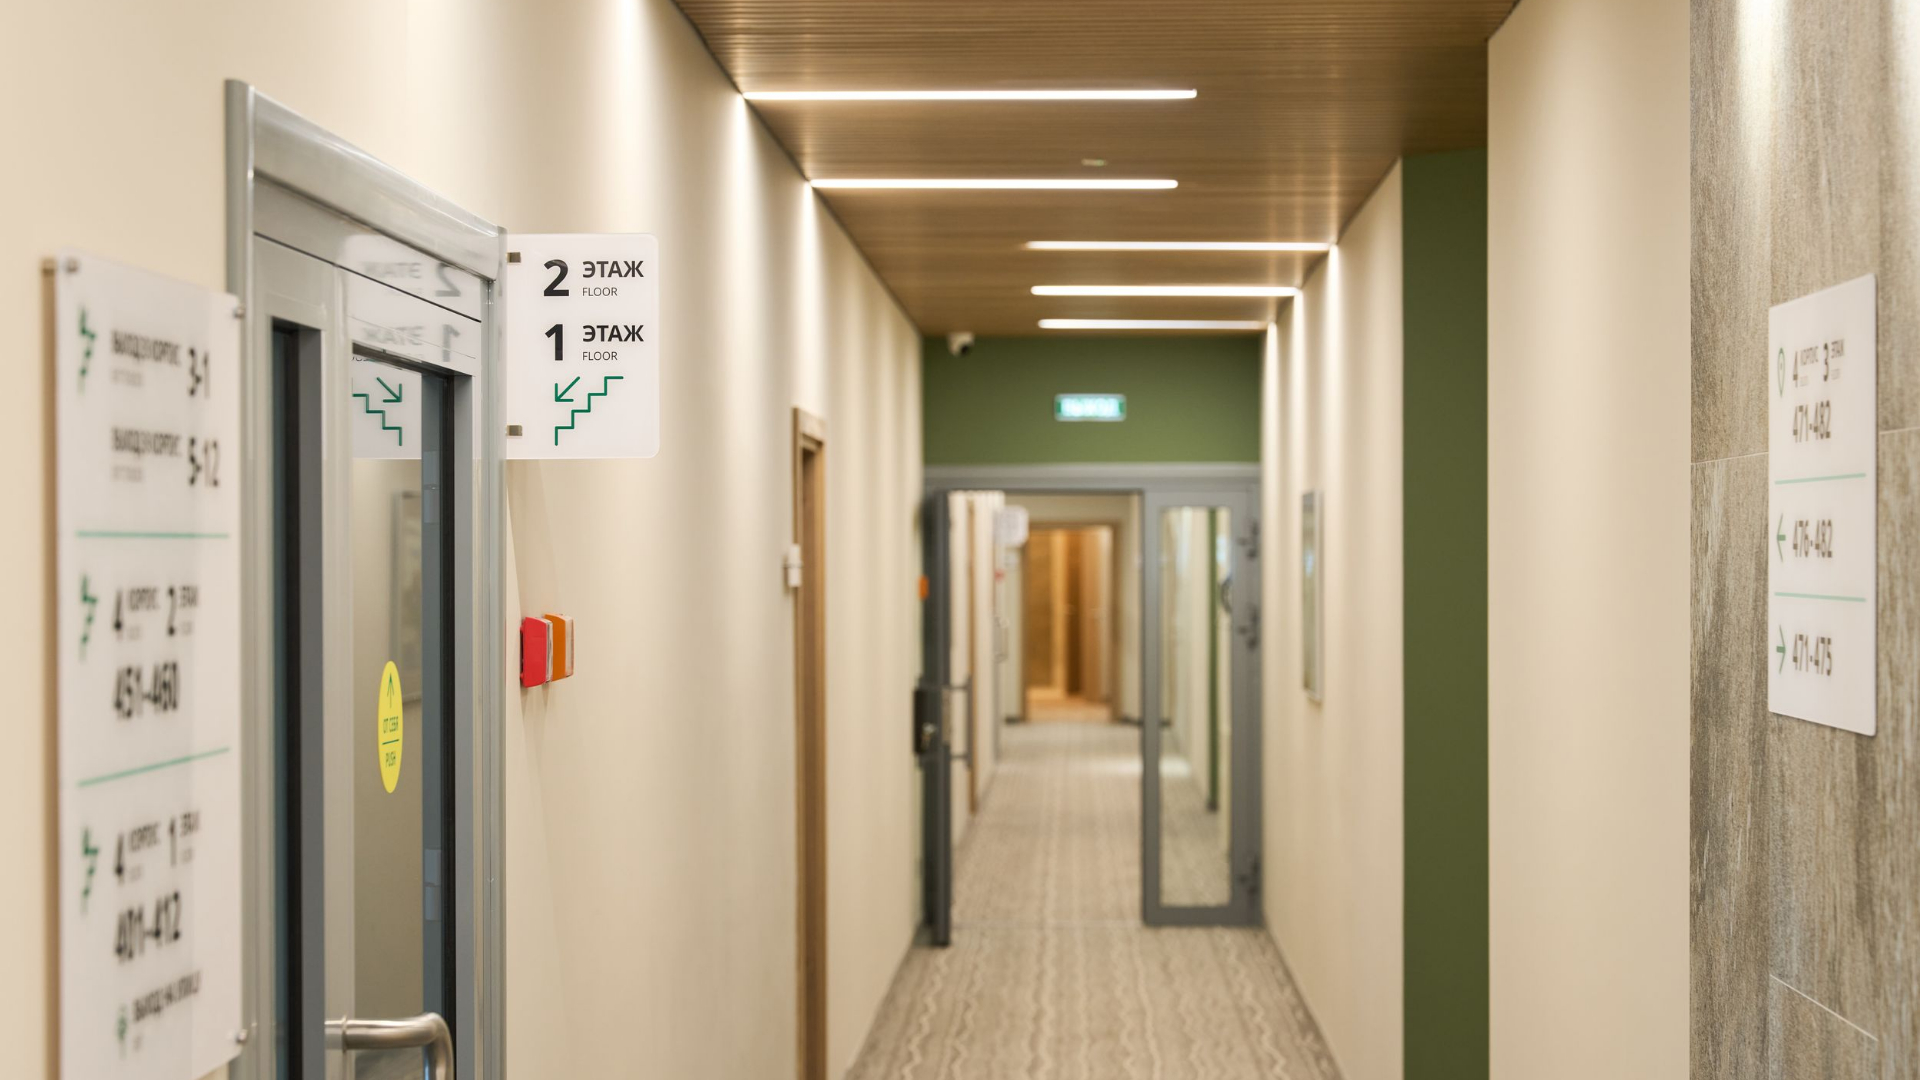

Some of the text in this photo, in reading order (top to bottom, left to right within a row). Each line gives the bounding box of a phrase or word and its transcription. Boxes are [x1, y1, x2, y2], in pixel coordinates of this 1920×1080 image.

[543, 258, 644, 297] 2 ЭТАЖ
[582, 287, 618, 297] FLOOR
[545, 323, 644, 361] 1 ЭТАЖ
[582, 351, 618, 361] FLOOR
[1793, 350, 1799, 388] 4
[1823, 342, 1829, 382] 3
[1792, 400, 1831, 443] 471-482
[1792, 518, 1833, 560] 476-482
[1792, 633, 1832, 678] 471-475
[385, 752, 396, 768] PUSH
